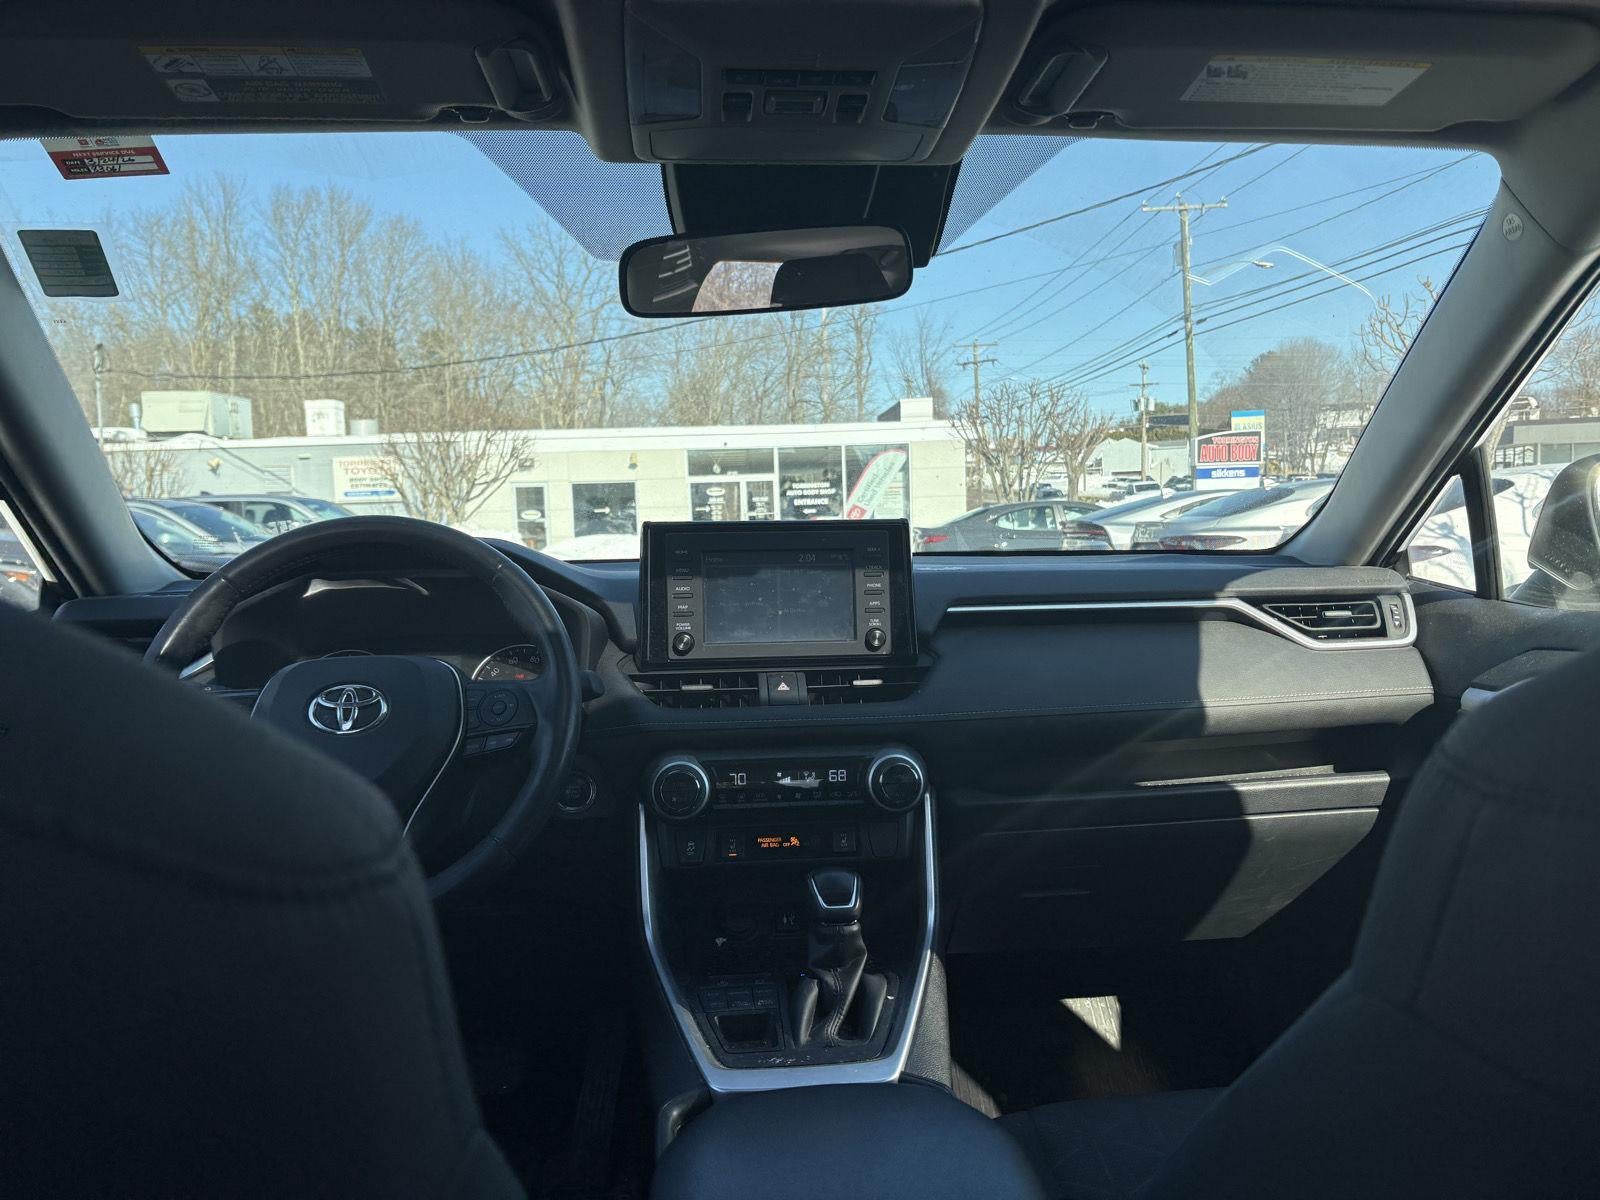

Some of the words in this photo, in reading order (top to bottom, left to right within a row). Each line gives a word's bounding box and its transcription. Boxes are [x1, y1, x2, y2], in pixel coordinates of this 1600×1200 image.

[91, 149, 120, 157] SERVICE
[1200, 445, 1228, 463] AUTO
[1230, 444, 1259, 462] BODY
[1211, 468, 1246, 478] sikkens
[793, 498, 829, 506] ENTRANCE
[490, 667, 500, 677] 40
[729, 773, 747, 786] 70
[828, 769, 847, 782] 68
